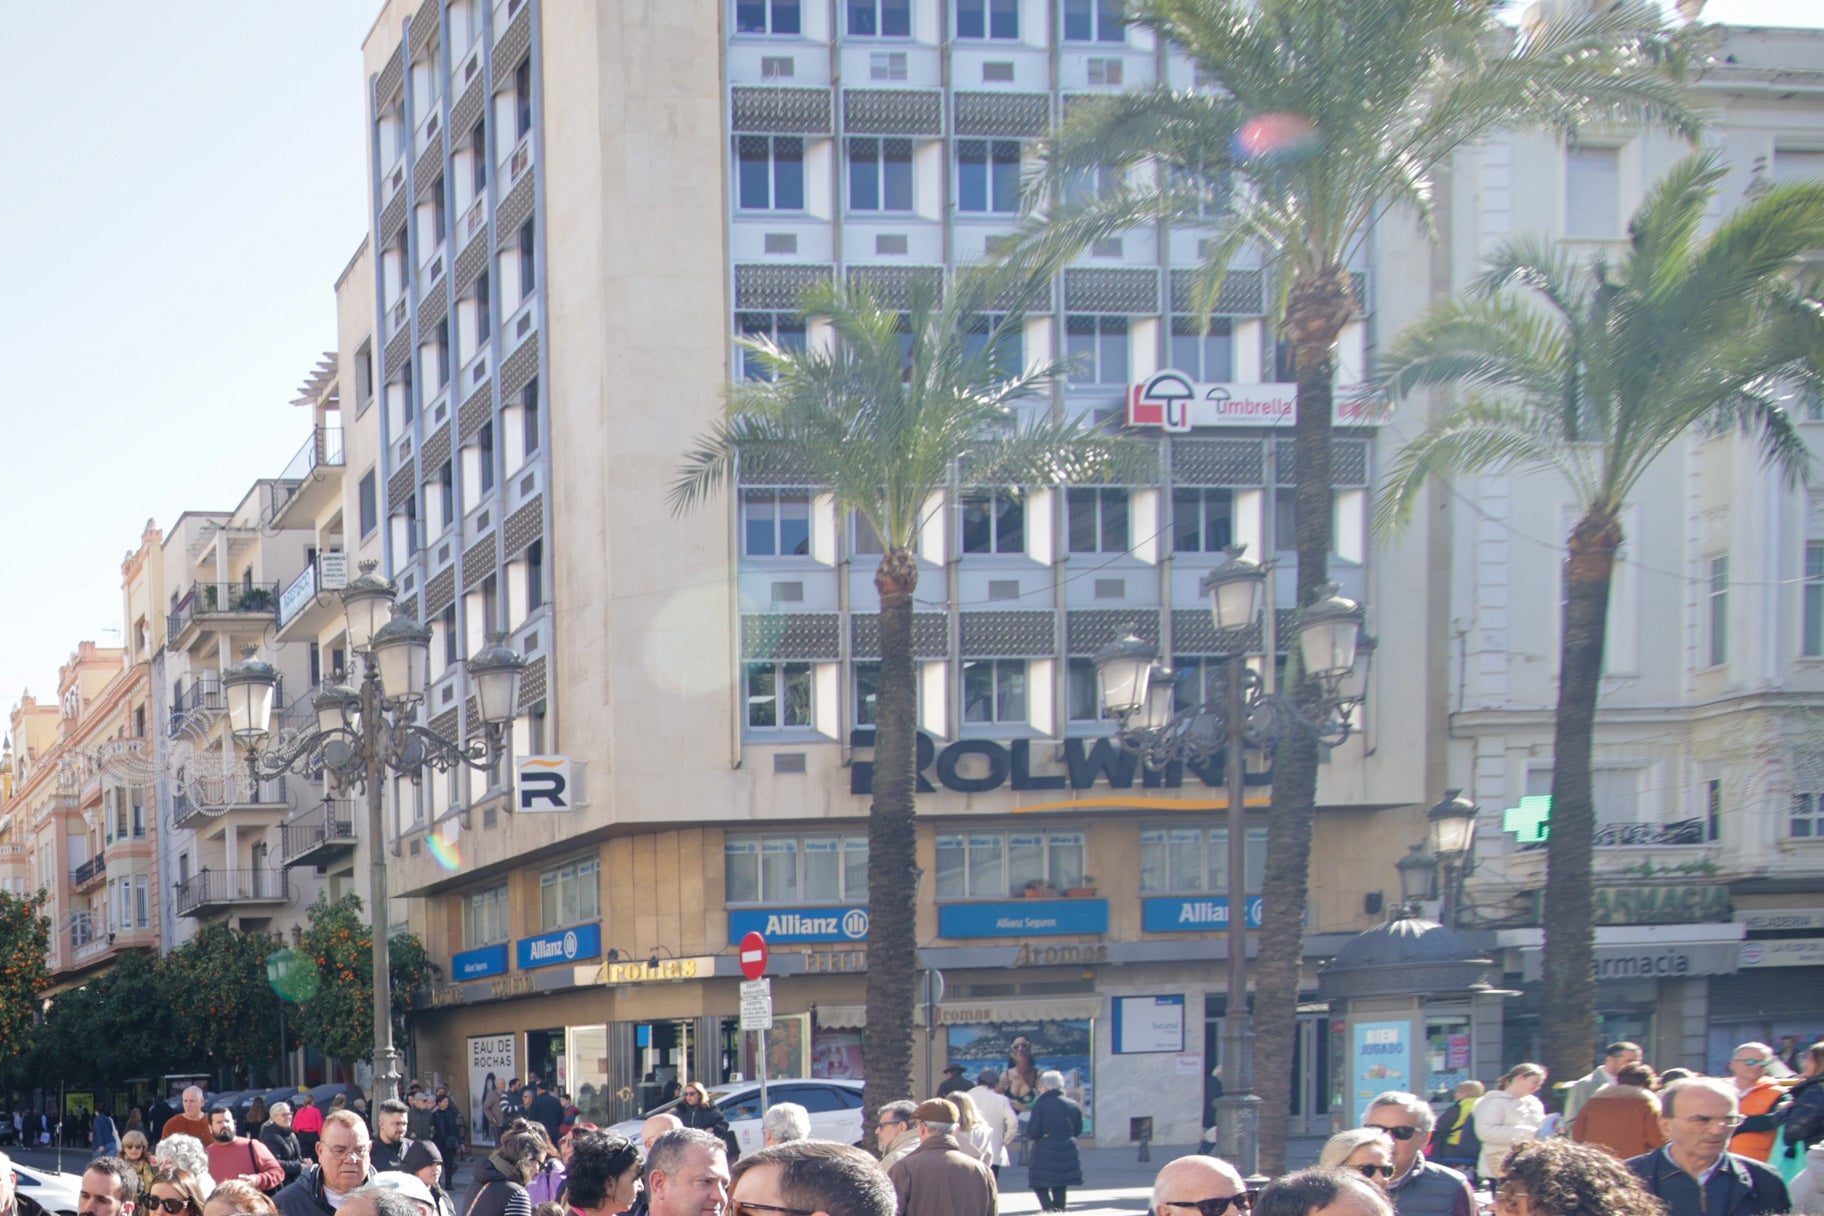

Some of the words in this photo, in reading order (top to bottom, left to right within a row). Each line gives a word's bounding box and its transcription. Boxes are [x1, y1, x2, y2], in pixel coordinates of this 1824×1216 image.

[850, 729, 1274, 794] ROLWIN
[765, 914, 839, 936] Allianz
[997, 918, 1023, 929] Allianz
[1025, 917, 1056, 929] Seguros
[530, 939, 563, 961] Allianz
[1013, 943, 1108, 967] Aromas
[1592, 947, 1689, 975] armacia
[595, 959, 696, 984] Aromas
[474, 1040, 493, 1055] EAU
[498, 1039, 511, 1051] DE
[474, 1055, 512, 1068] ROCHAS
